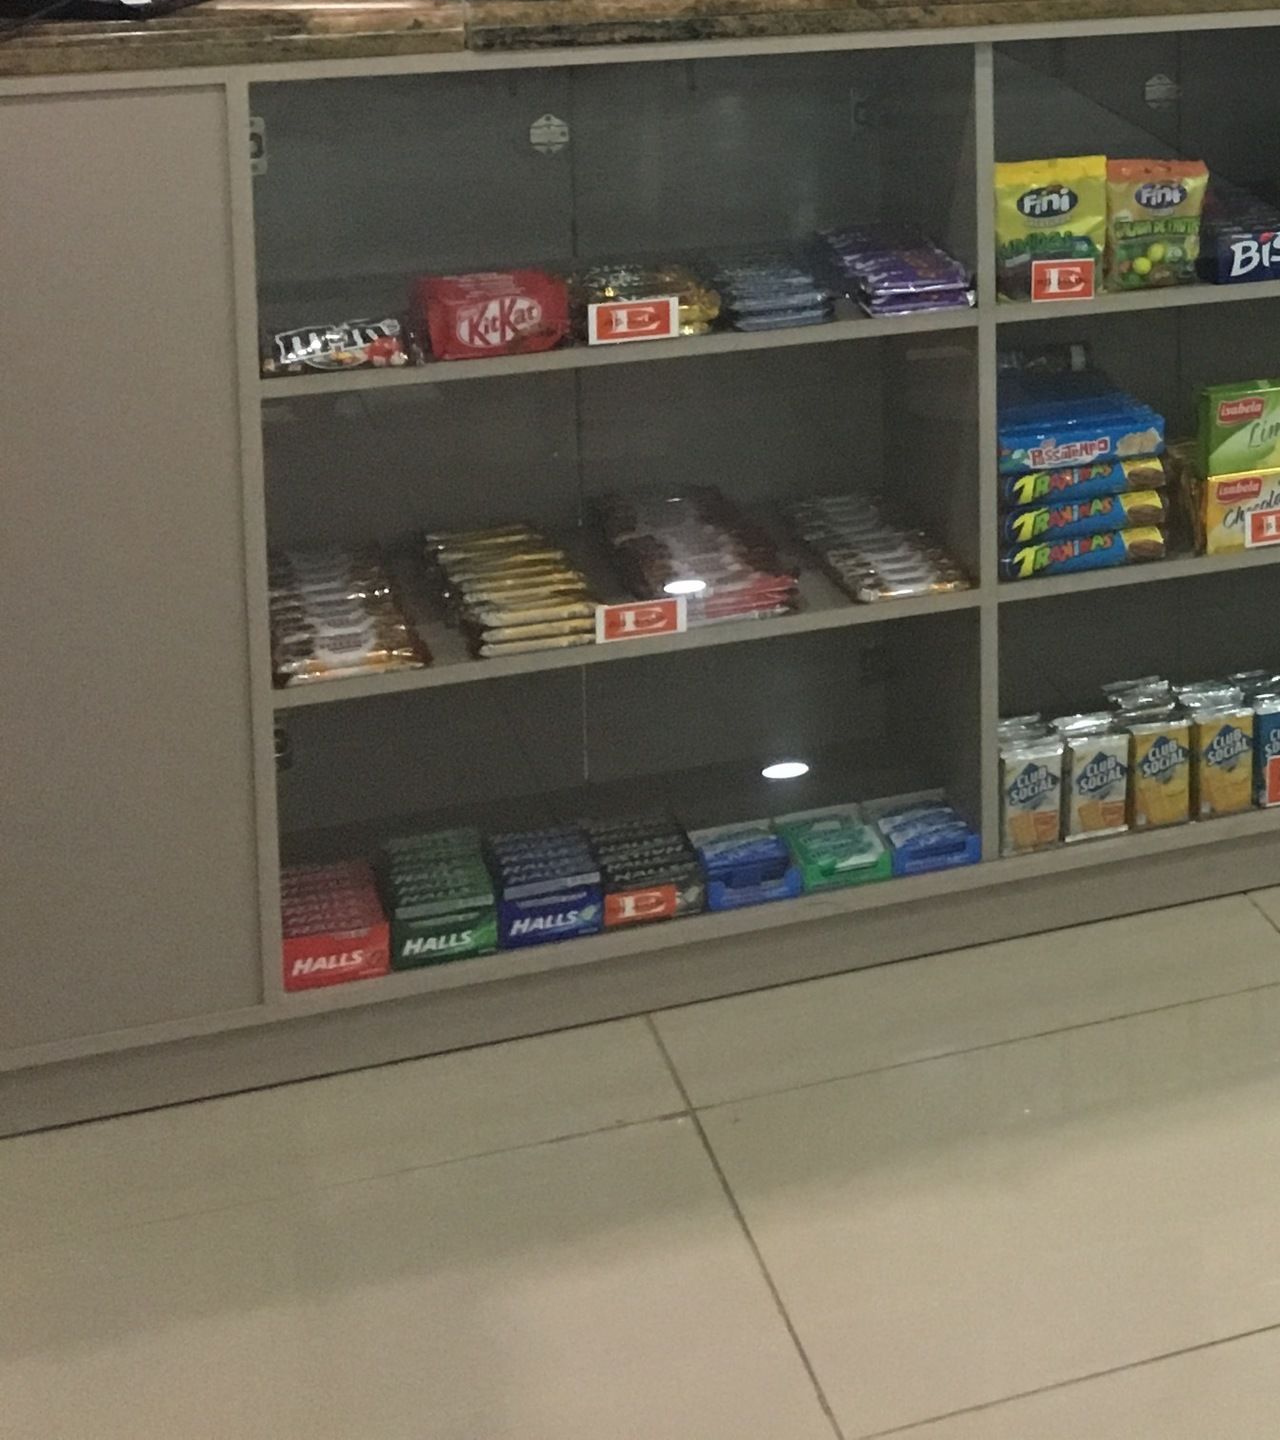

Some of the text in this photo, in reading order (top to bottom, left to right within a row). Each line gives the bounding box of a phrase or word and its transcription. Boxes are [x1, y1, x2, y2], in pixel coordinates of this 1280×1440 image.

[1023, 187, 1070, 214] Fini
[1141, 184, 1182, 205] Fini
[1044, 266, 1085, 293] E
[467, 297, 535, 345] KitKat
[1148, 738, 1177, 761] CLUB
[1211, 727, 1241, 750] CLUB
[1017, 765, 1047, 789] CLUB
[1085, 756, 1116, 778] CLUB
[510, 910, 579, 936] HALLS
[402, 930, 473, 957] HALLS
[292, 950, 364, 976] HALLS
